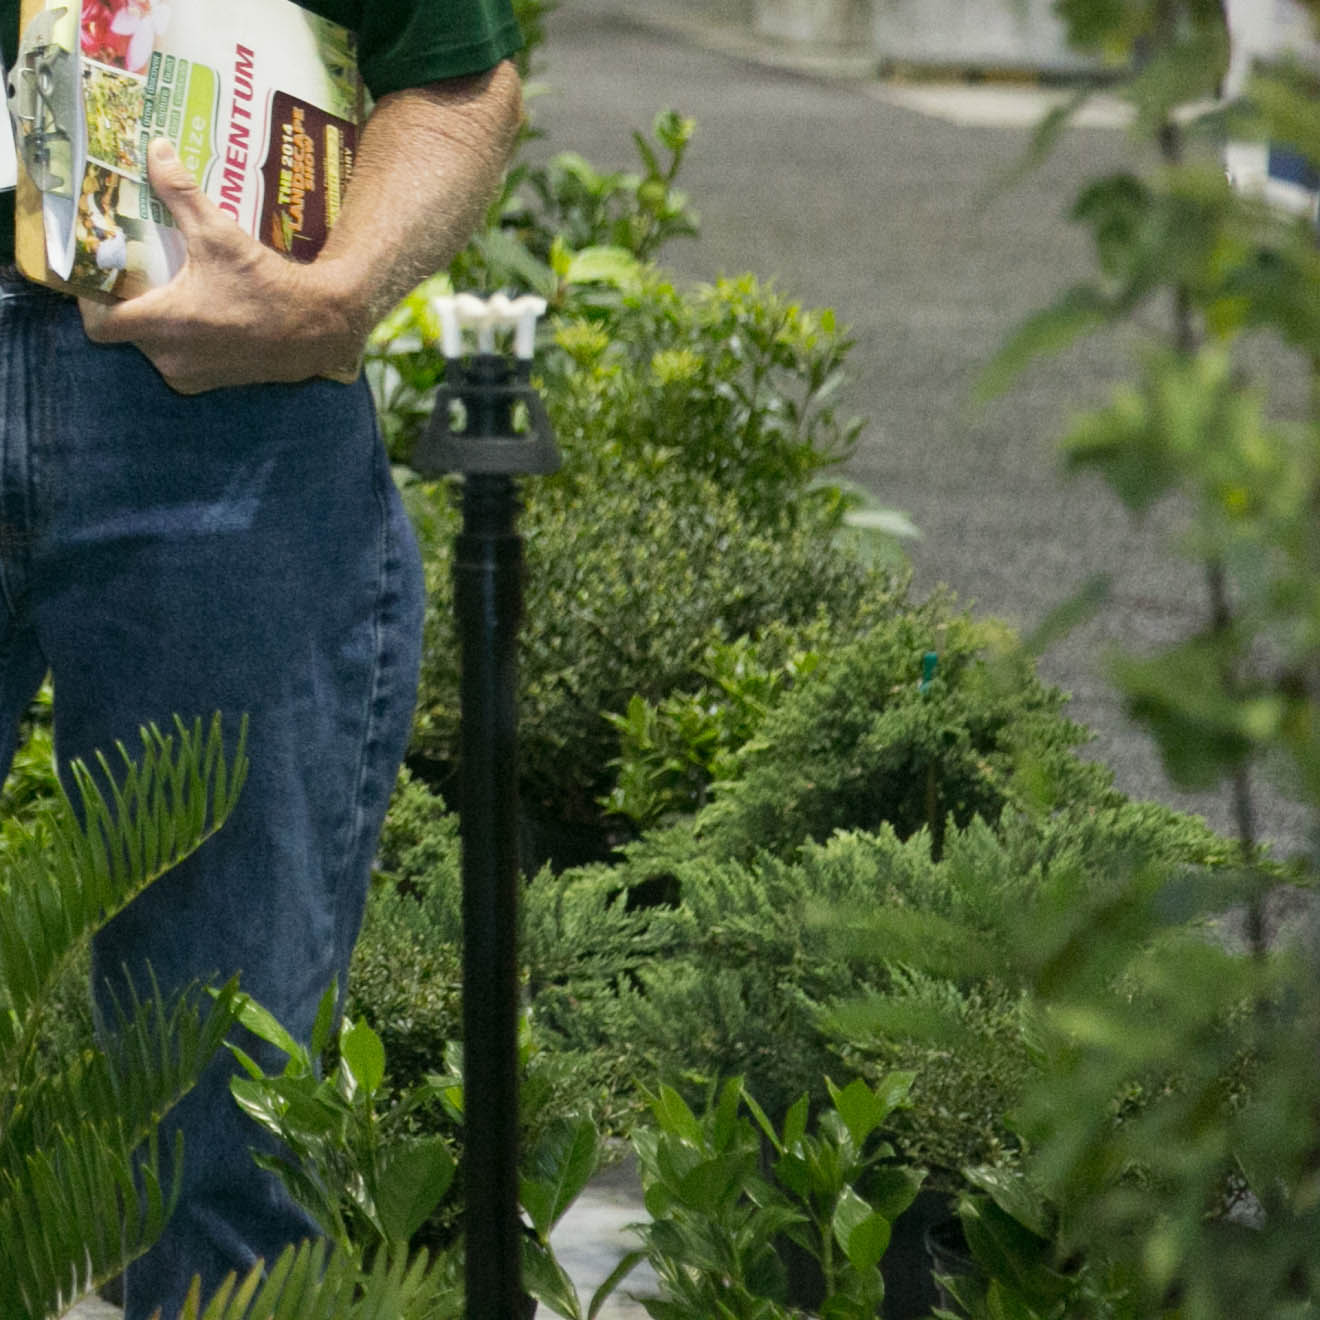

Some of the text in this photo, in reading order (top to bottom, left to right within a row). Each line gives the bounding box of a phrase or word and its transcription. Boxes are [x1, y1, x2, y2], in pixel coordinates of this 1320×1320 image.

[278, 123, 293, 205] THE 2014
[287, 106, 305, 232] LANDSCAPE
[303, 135, 315, 192] SHOW
